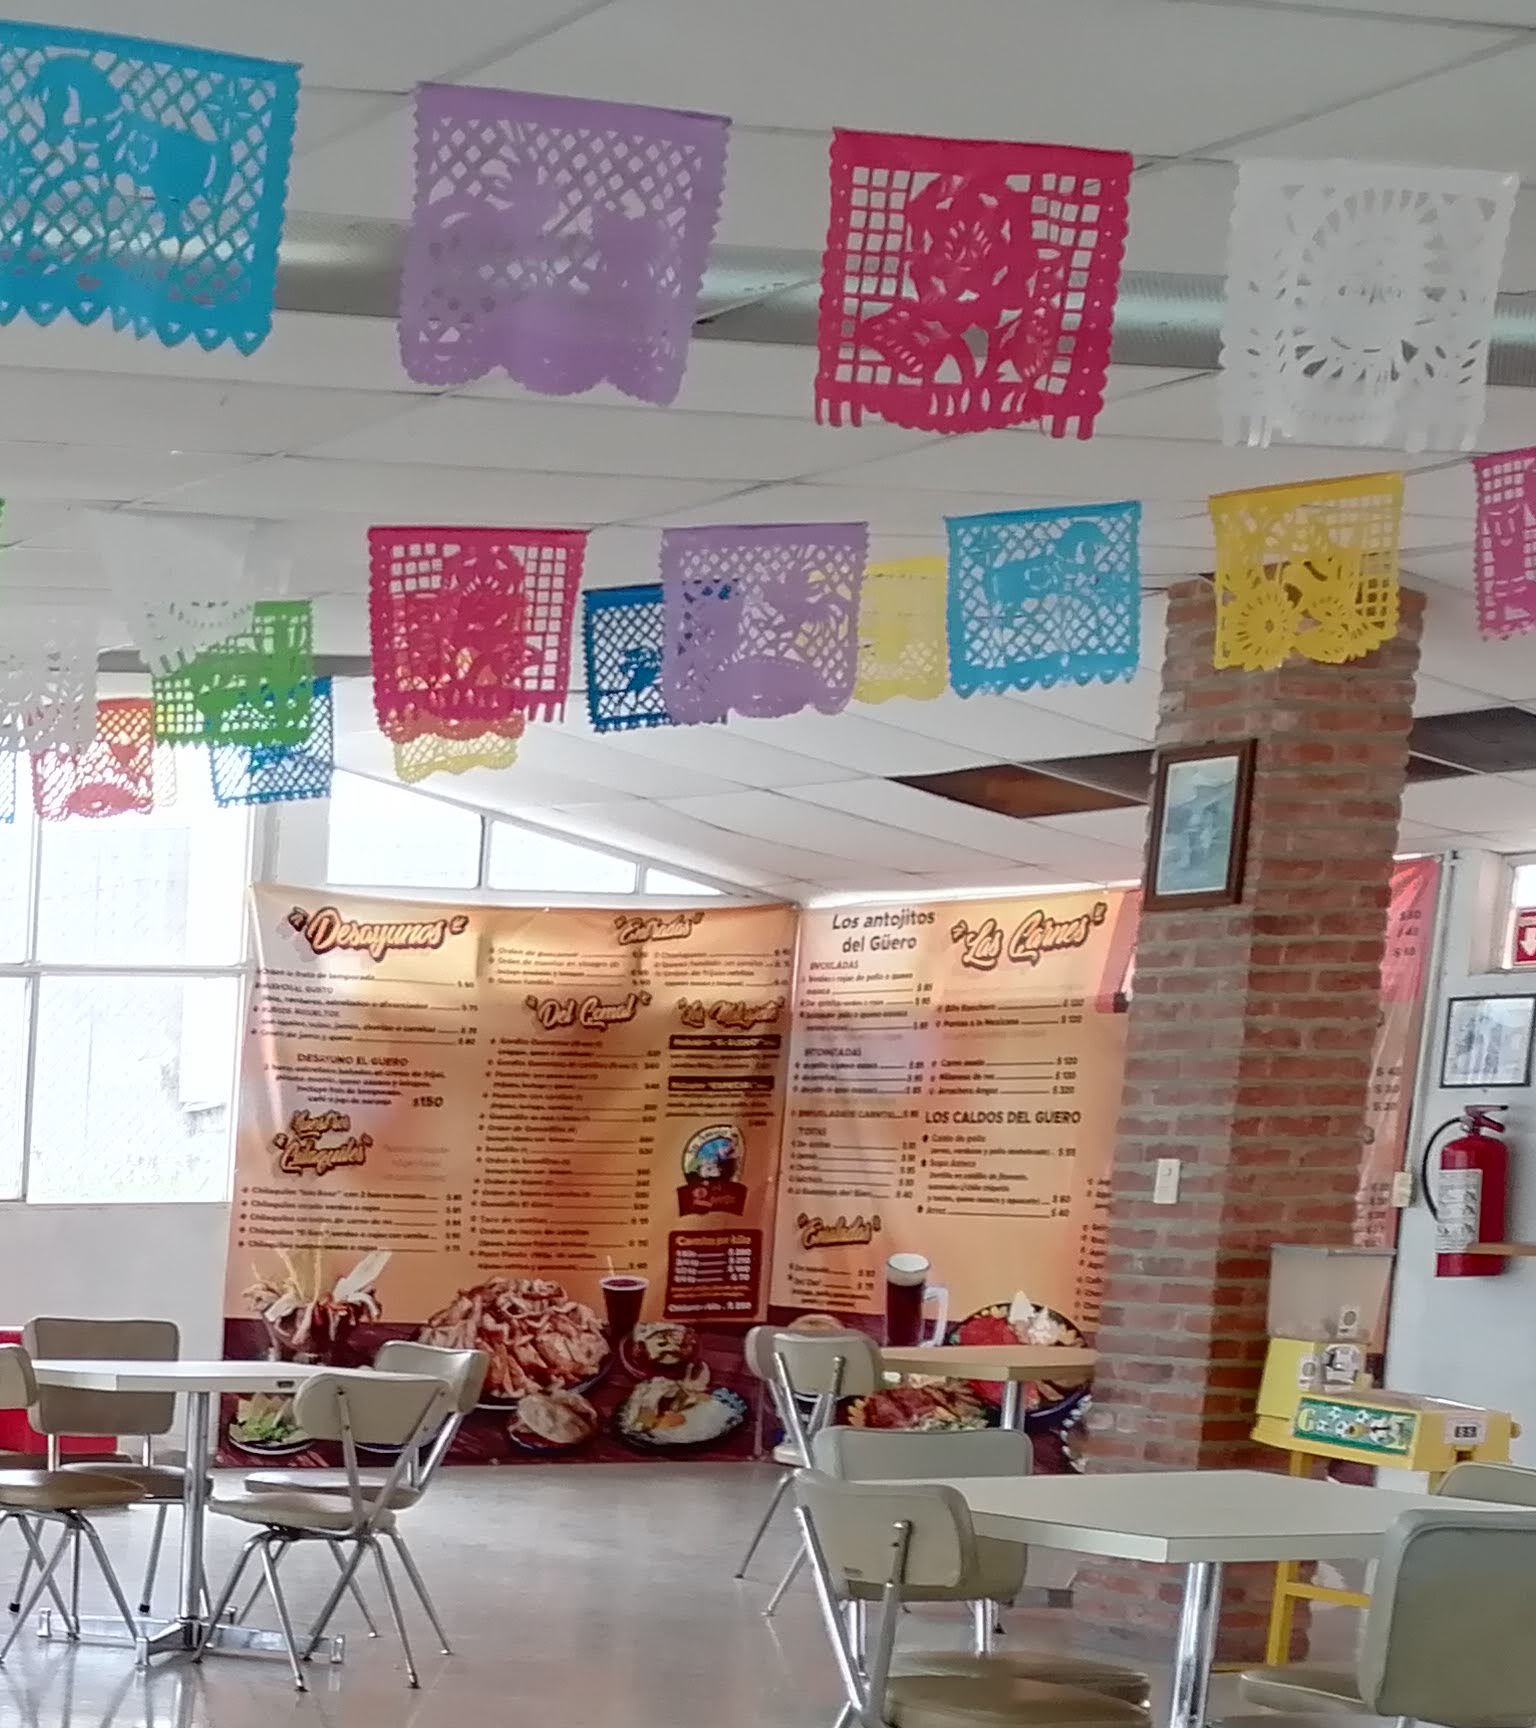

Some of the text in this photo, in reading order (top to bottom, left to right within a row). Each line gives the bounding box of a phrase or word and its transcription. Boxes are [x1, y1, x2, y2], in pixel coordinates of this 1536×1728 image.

[832, 908, 935, 930] Los antojitos
[842, 934, 917, 953] del Güero
[925, 1110, 950, 1125] LOS
[953, 1110, 1004, 1125] CALDOS
[1007, 1110, 1030, 1125] DEL
